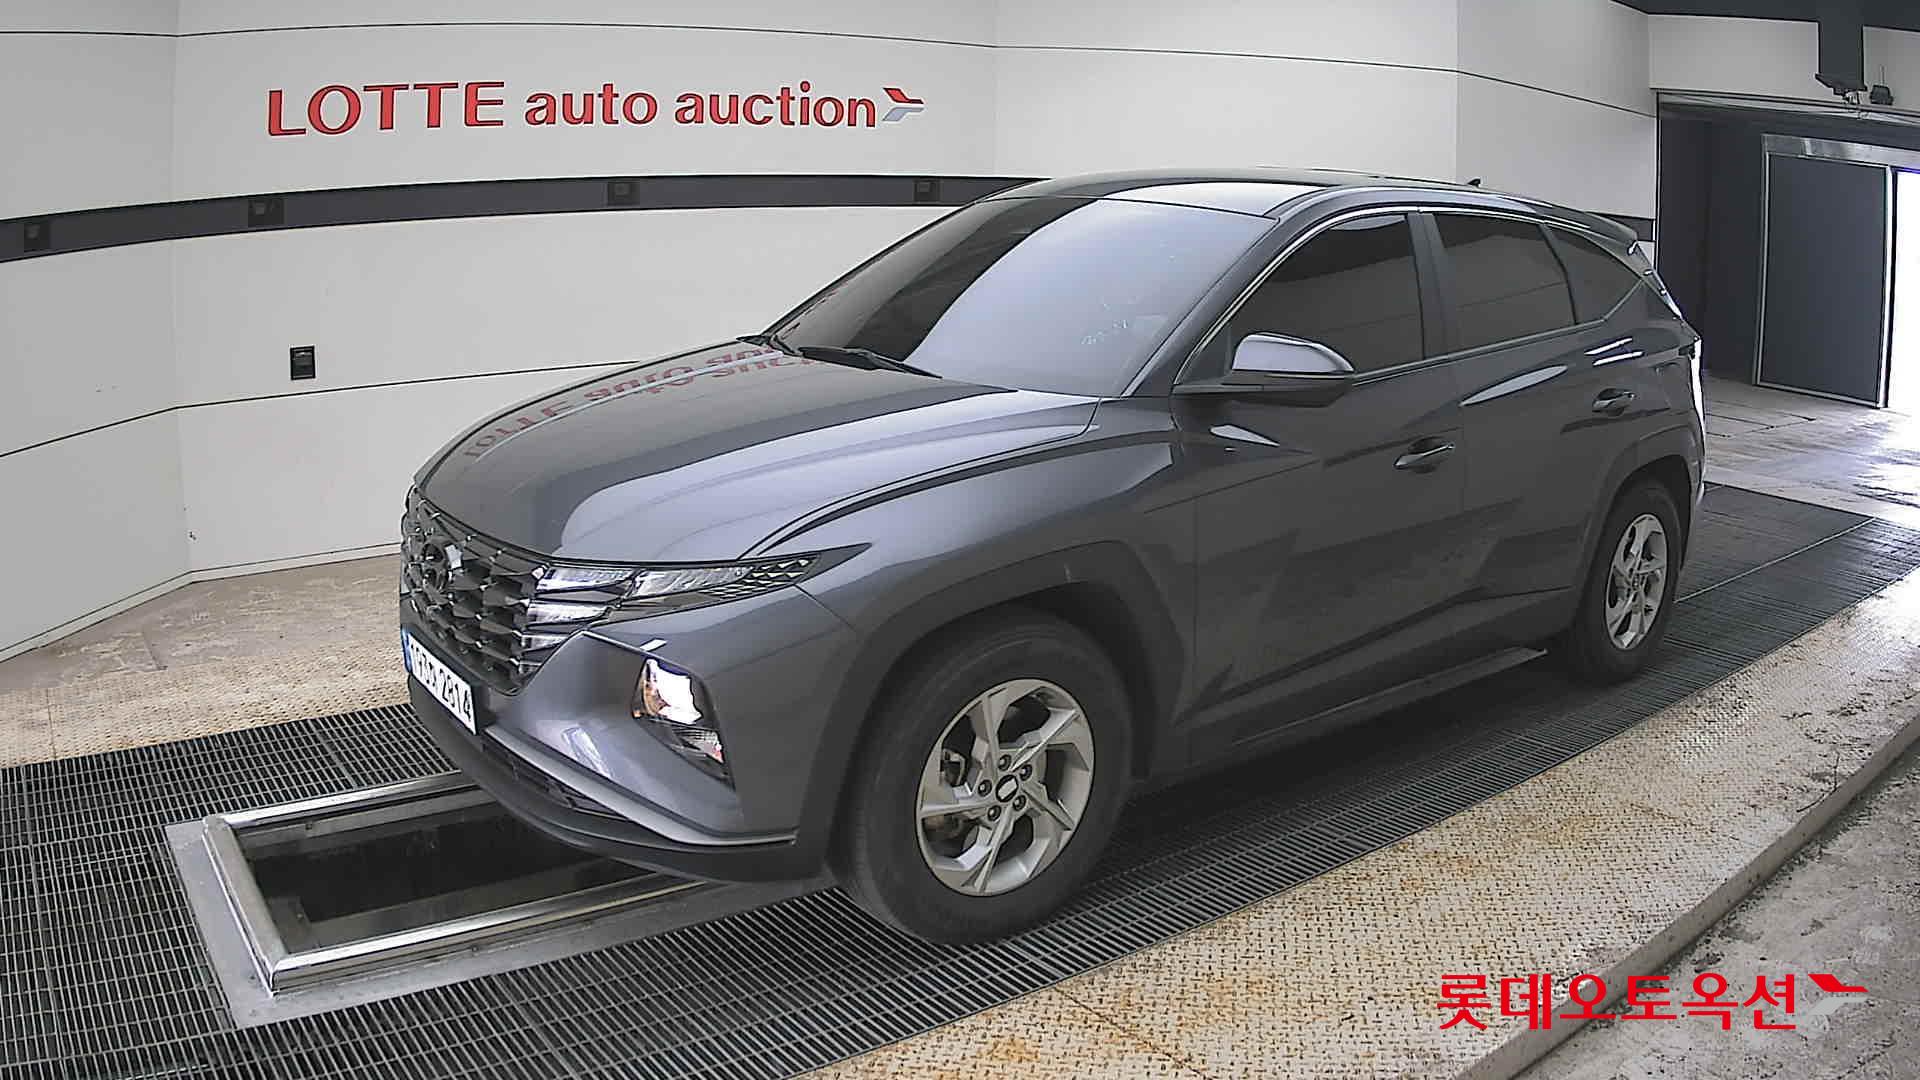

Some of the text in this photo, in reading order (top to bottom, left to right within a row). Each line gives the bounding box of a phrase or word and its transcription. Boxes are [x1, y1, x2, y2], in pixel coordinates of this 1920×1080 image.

[267, 81, 877, 137] LOTTE auto auction
